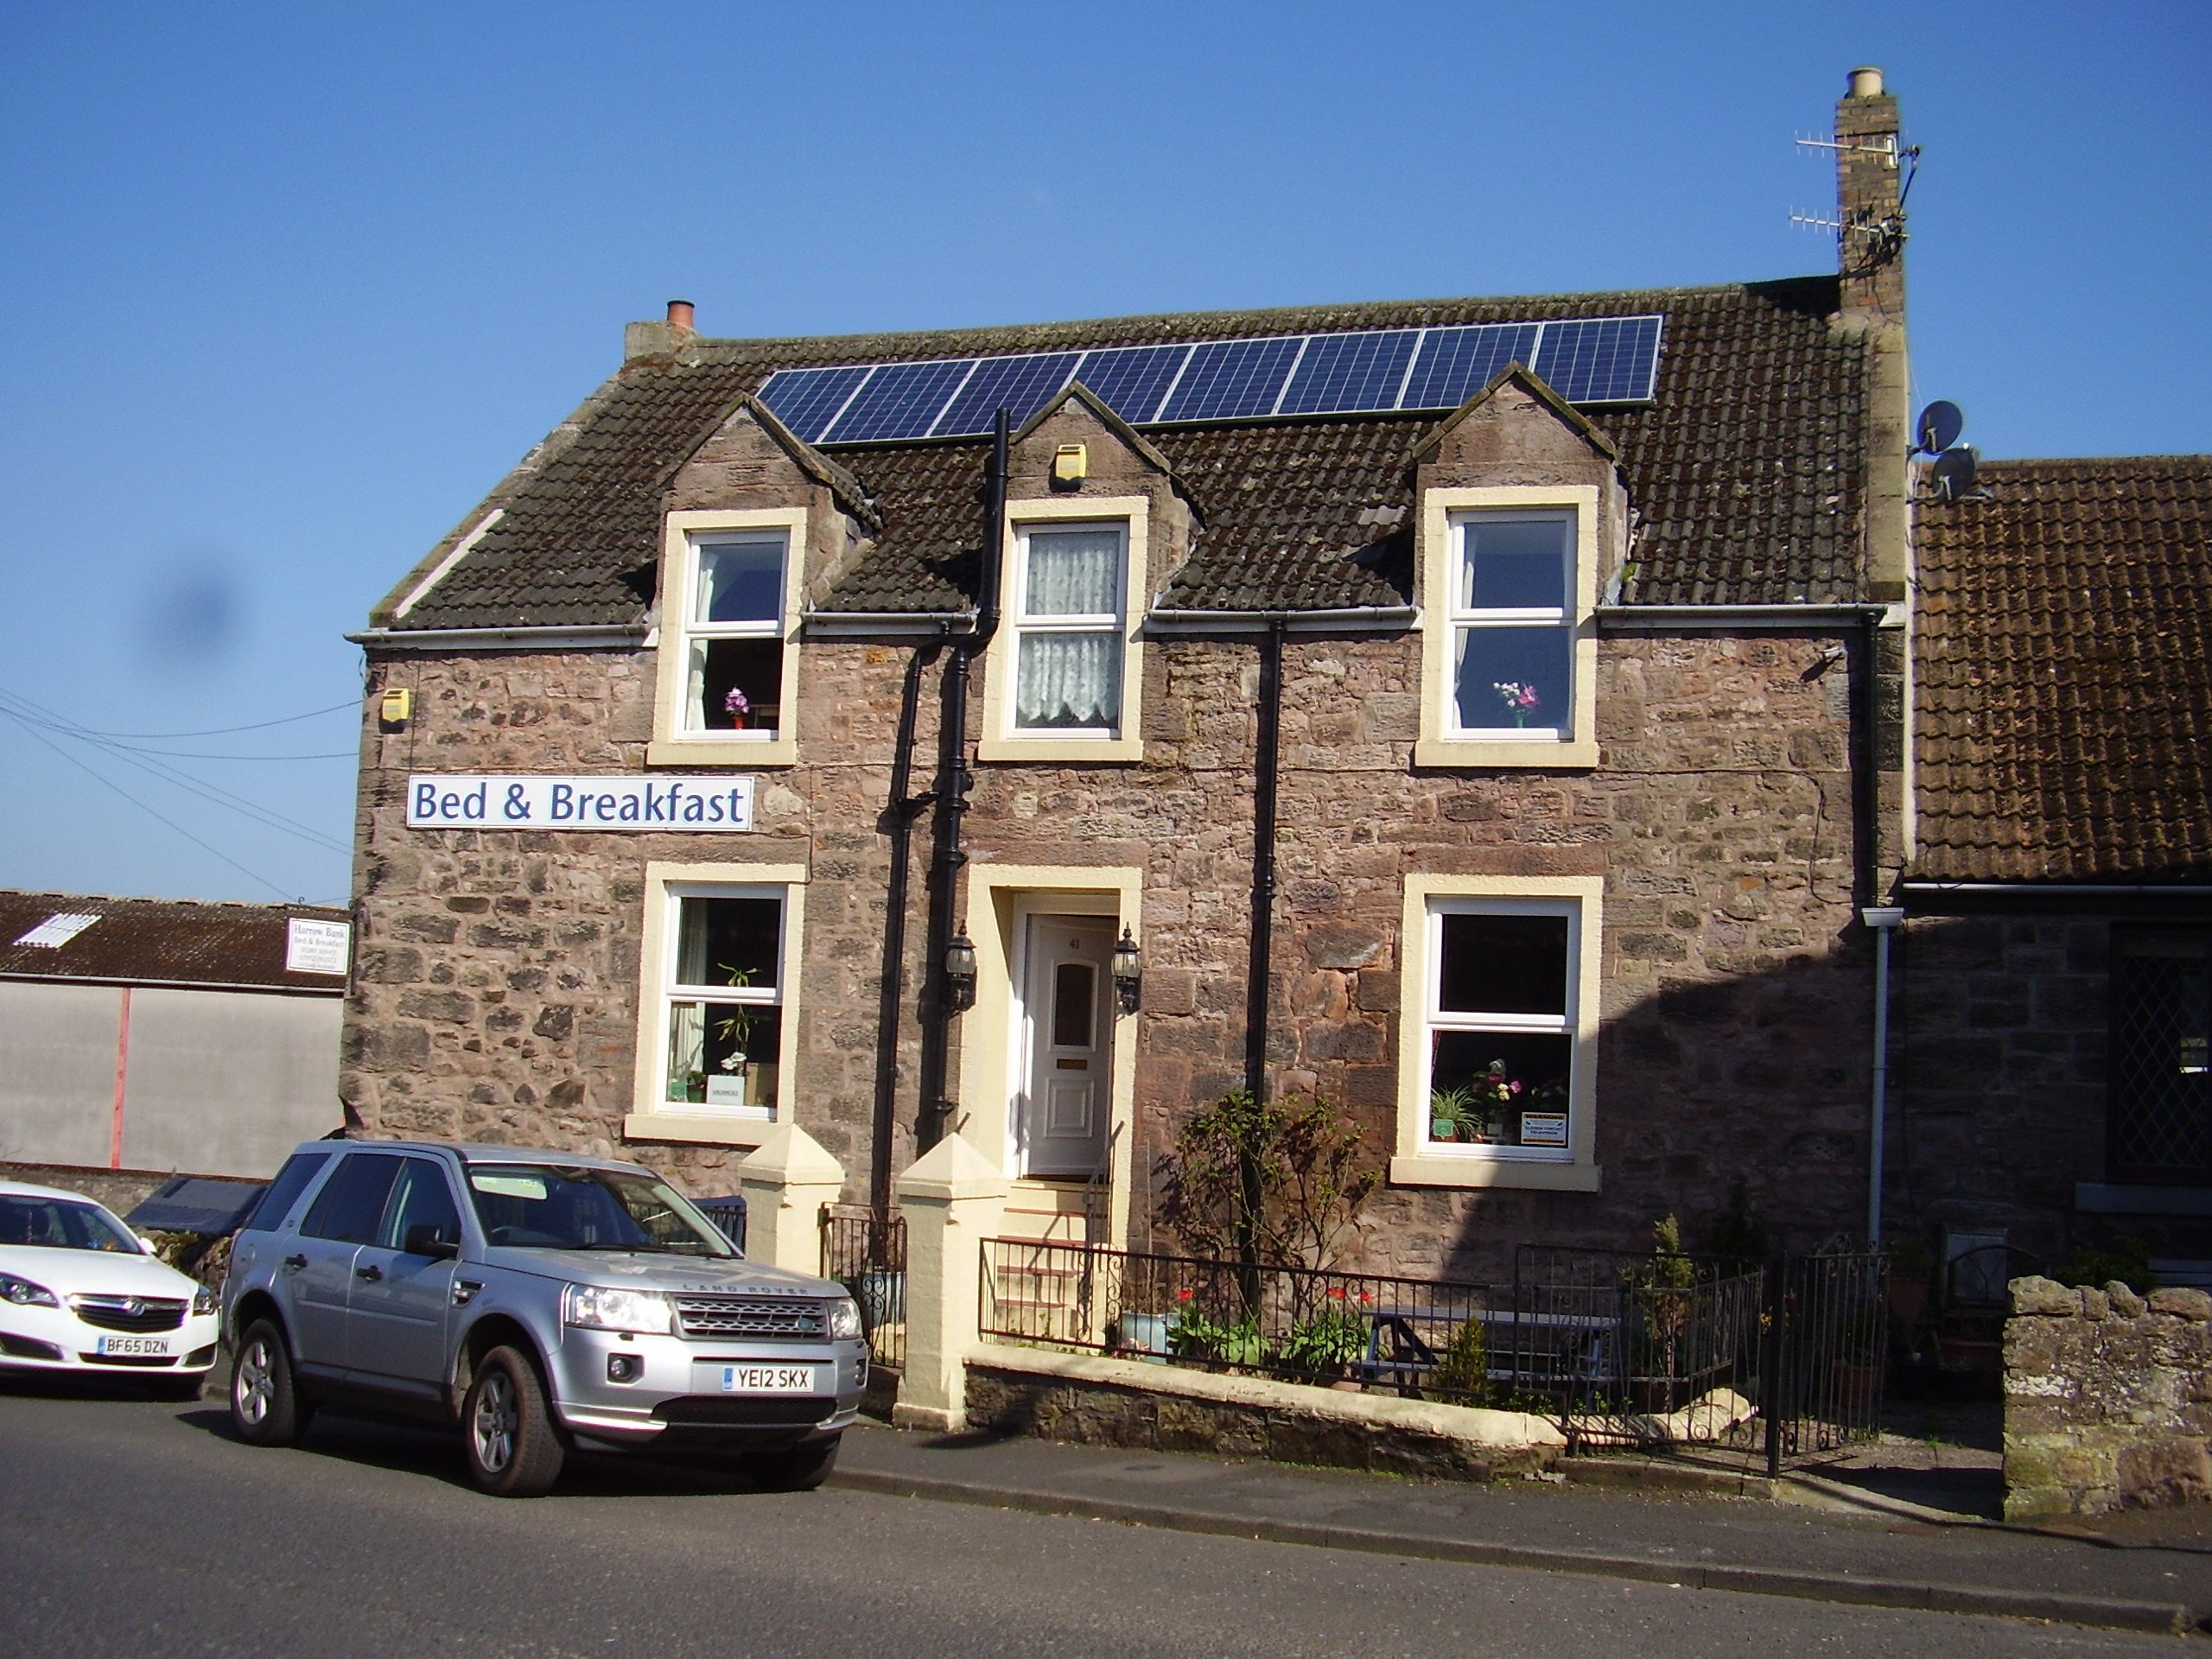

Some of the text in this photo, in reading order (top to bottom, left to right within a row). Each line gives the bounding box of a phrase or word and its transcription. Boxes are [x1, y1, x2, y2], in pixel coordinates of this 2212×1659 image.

[415, 781, 744, 823] Bed & Breakfast
[295, 925, 344, 938] Harrow Bank
[1069, 938, 1079, 950] 41
[683, 1284, 809, 1295] LAND ROVER
[106, 1339, 168, 1353] BF65 DZN
[739, 1369, 809, 1388] YE12 SKX
